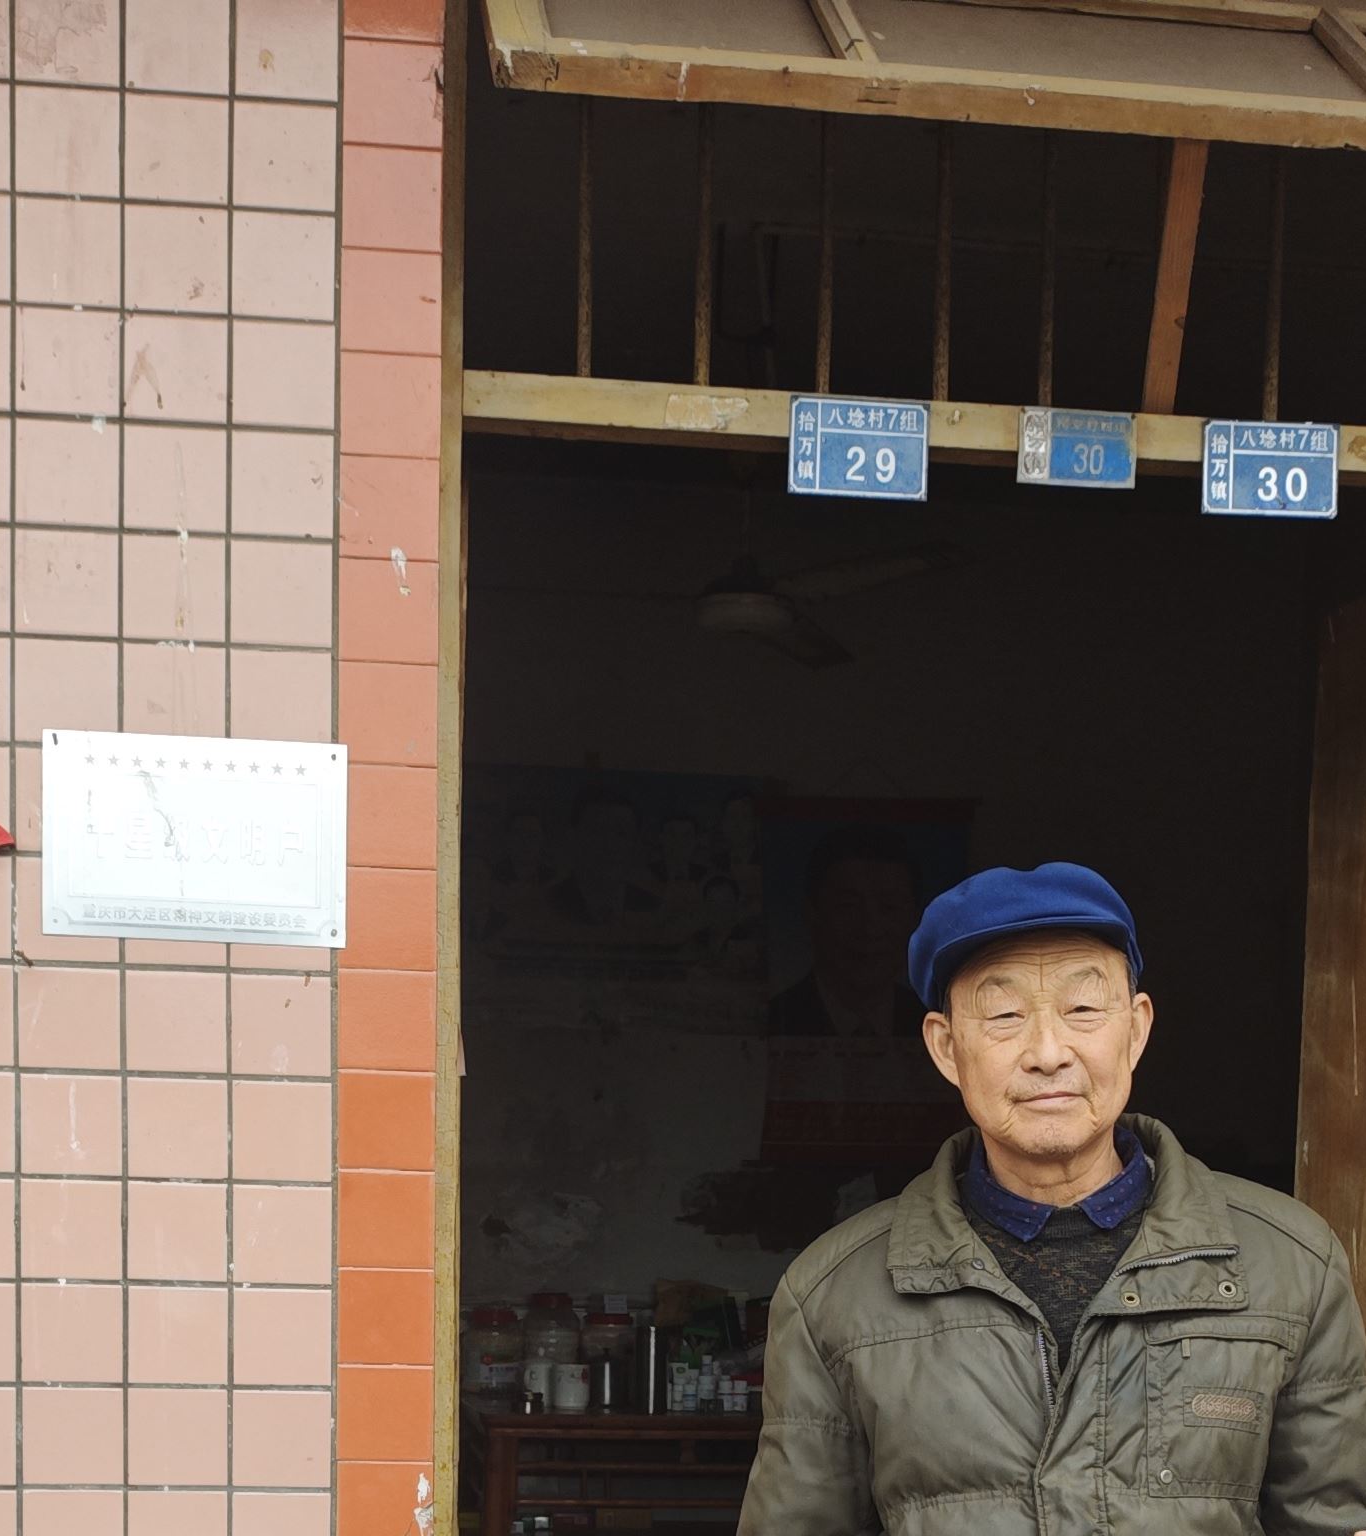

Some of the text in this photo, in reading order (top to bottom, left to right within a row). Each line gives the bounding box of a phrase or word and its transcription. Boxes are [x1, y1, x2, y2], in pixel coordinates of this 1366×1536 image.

[798, 411, 816, 480] 拾万镇
[1073, 442, 1105, 475] 30
[846, 446, 896, 483] 29
[1211, 433, 1229, 501] 拾万镇
[1257, 466, 1308, 502] 30
[82, 903, 308, 928] 重庆市大足区精神文明建设委员会
